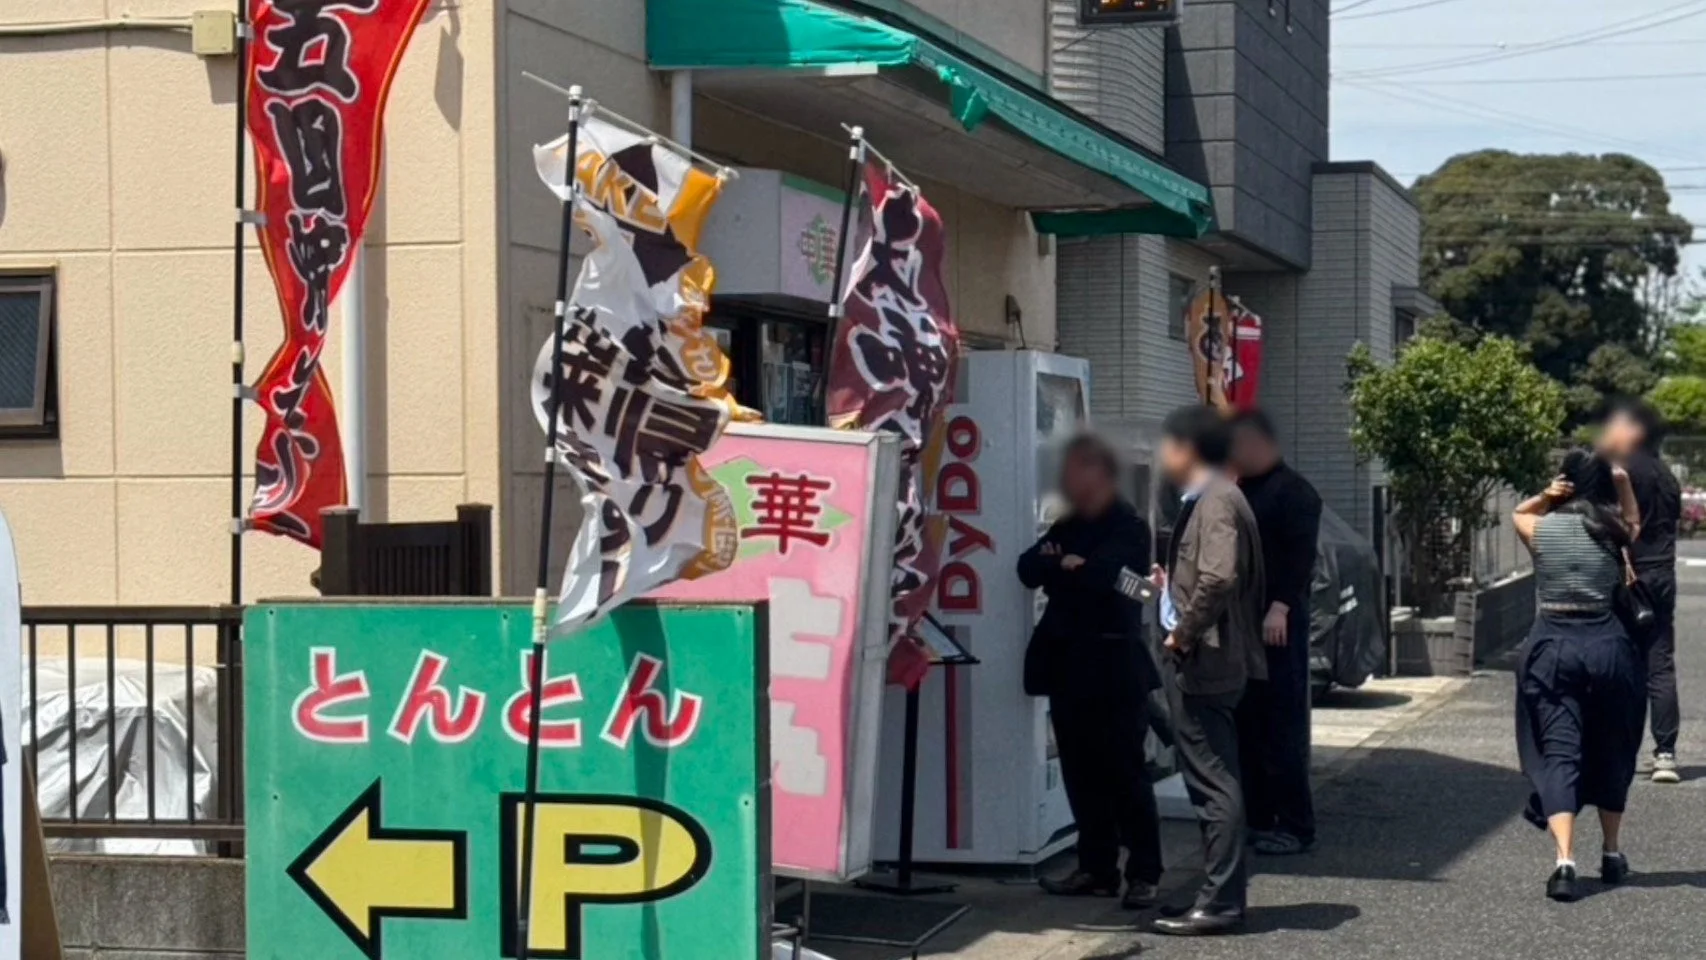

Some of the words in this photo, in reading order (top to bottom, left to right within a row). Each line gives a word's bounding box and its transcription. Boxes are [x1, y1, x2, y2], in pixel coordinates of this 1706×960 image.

[739, 470, 834, 556] 華
[936, 414, 996, 616] DyDo
[291, 646, 702, 749] とんとん
[499, 792, 712, 958] P
